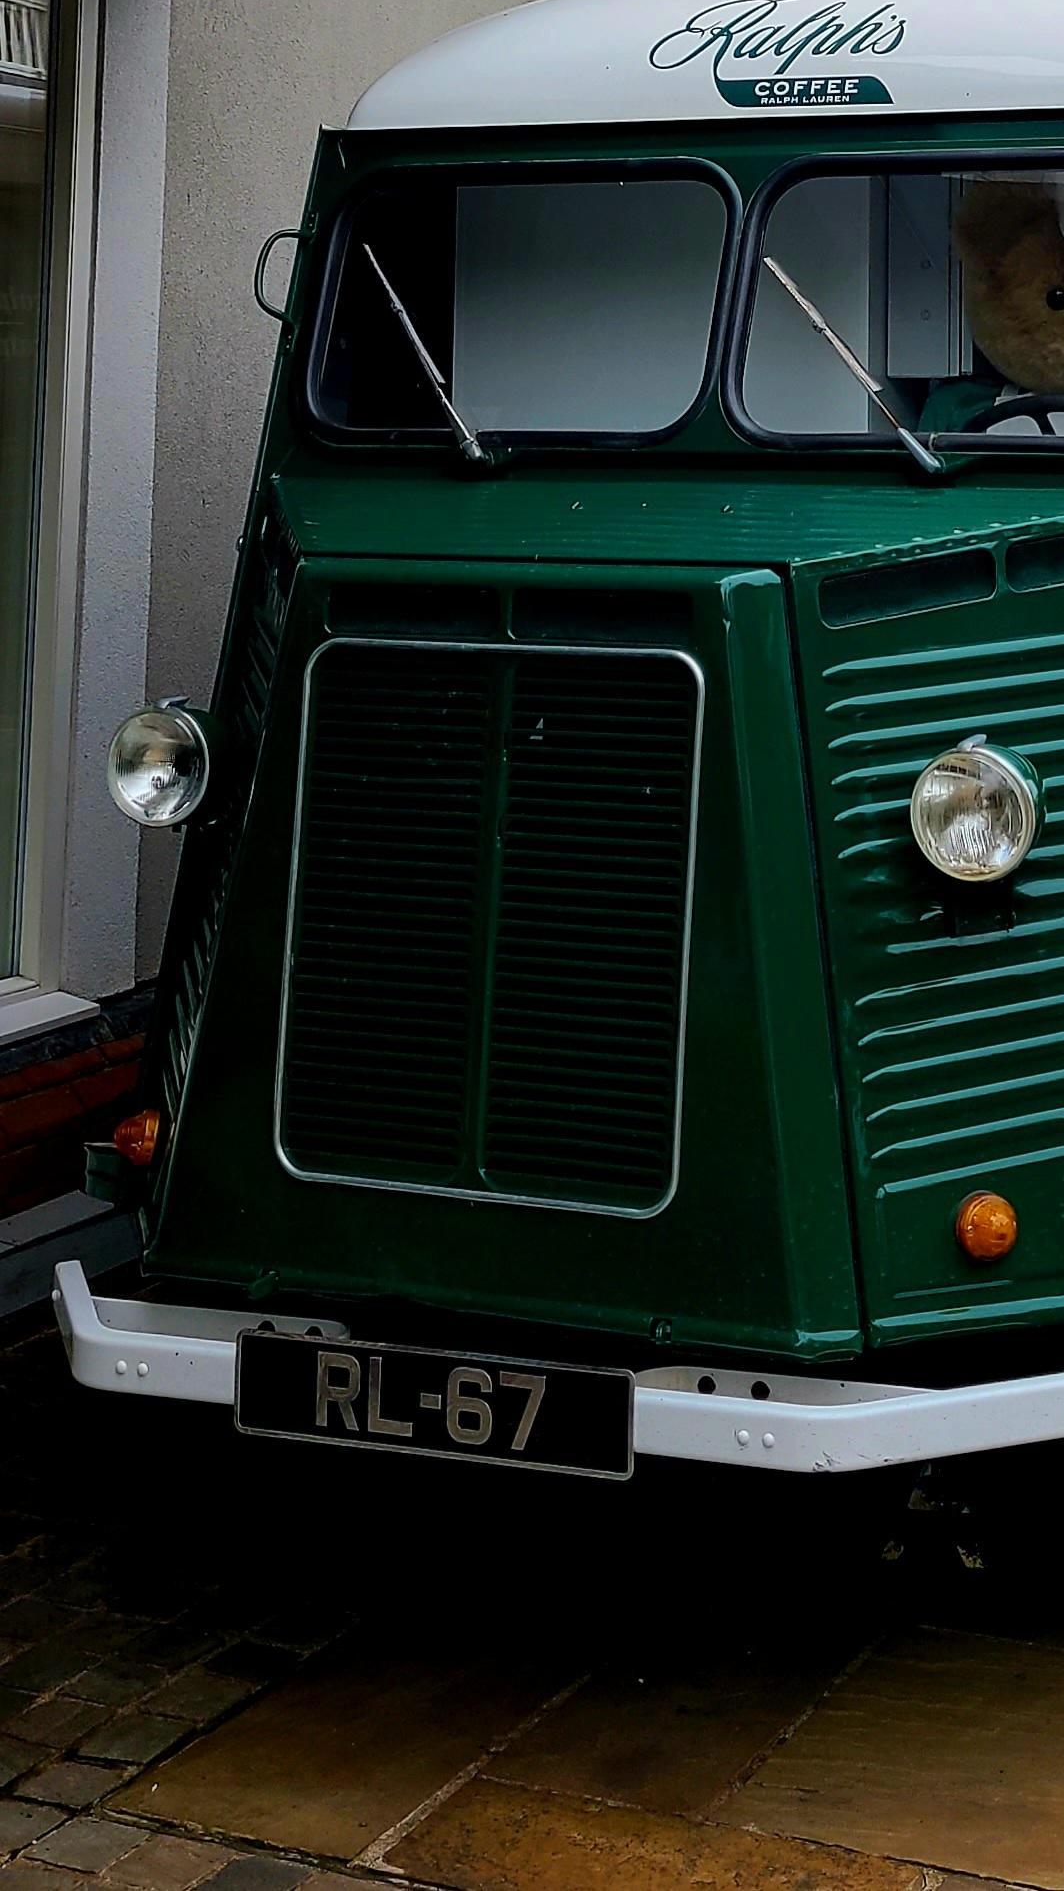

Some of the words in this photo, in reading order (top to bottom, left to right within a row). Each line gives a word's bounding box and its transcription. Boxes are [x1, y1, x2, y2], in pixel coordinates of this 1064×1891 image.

[754, 78, 860, 97] COFFEE
[760, 95, 800, 105] RALPH
[802, 94, 850, 104] LAUREN
[315, 1350, 547, 1451] RL-67
